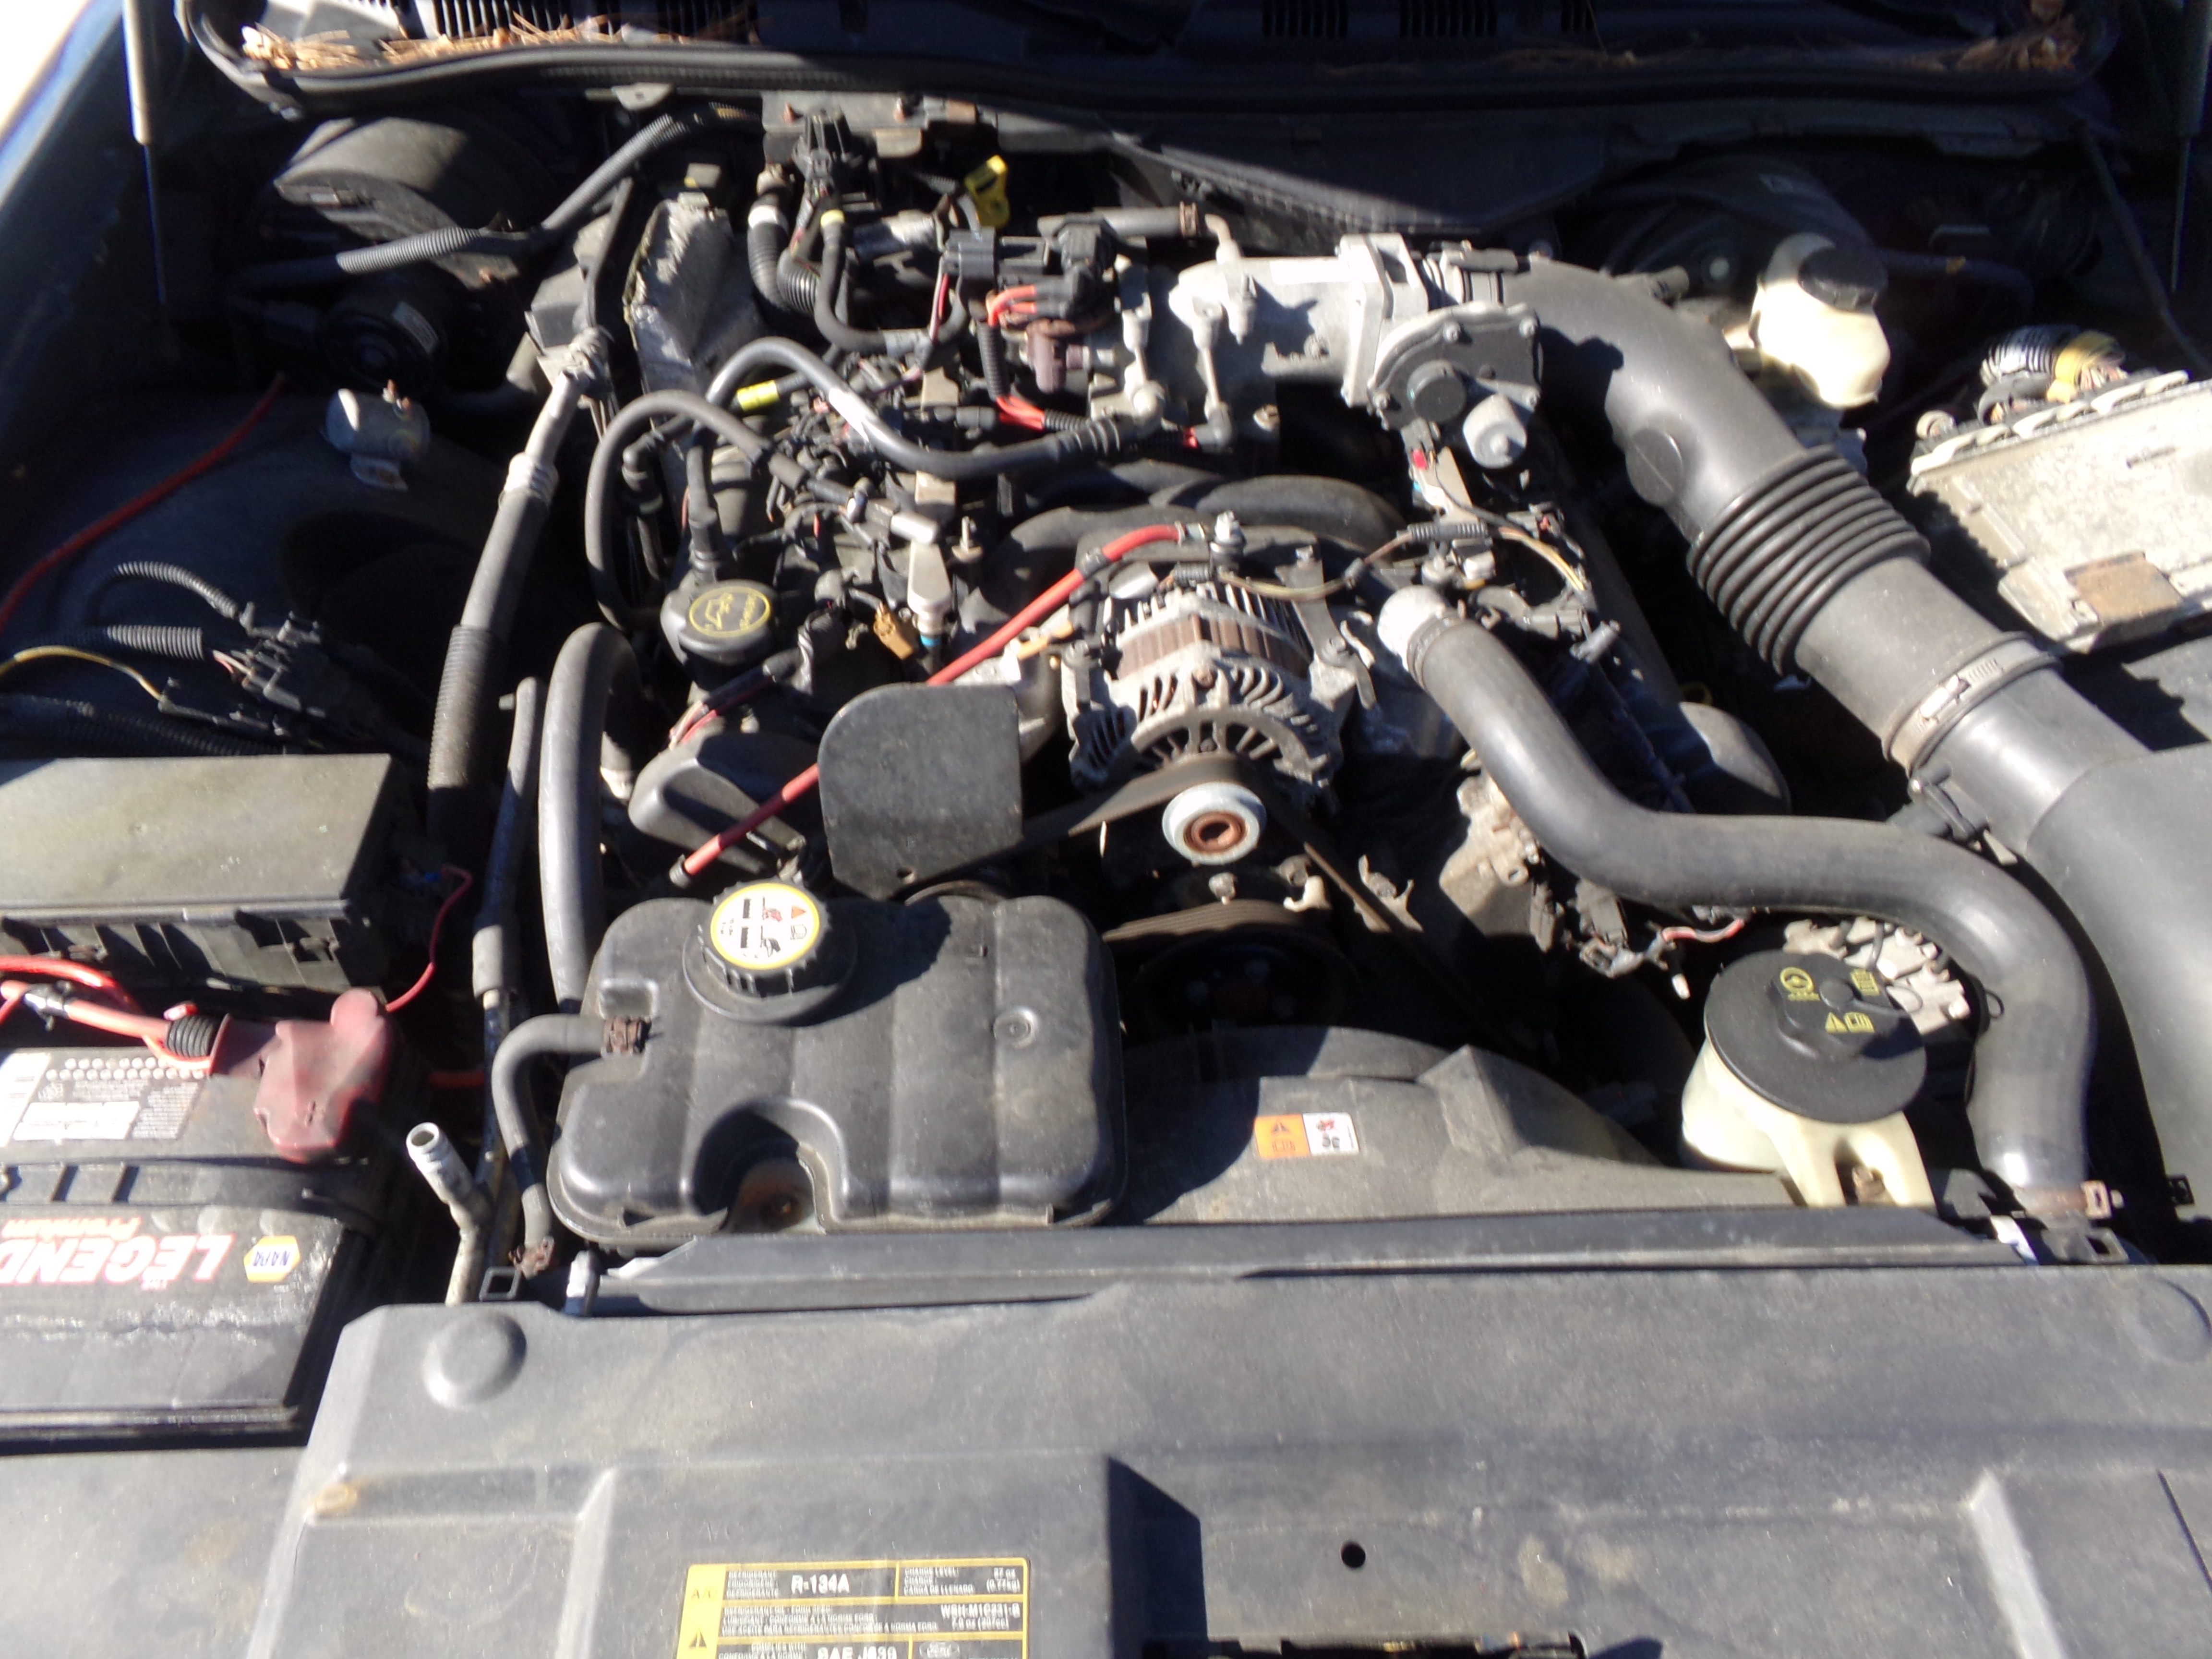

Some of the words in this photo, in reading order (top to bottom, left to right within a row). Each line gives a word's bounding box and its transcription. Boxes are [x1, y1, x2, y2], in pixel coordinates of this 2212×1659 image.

[0, 1234, 234, 1284] LEGEND
[252, 1250, 291, 1267] NAPA
[791, 1573, 850, 1595] R-134A
